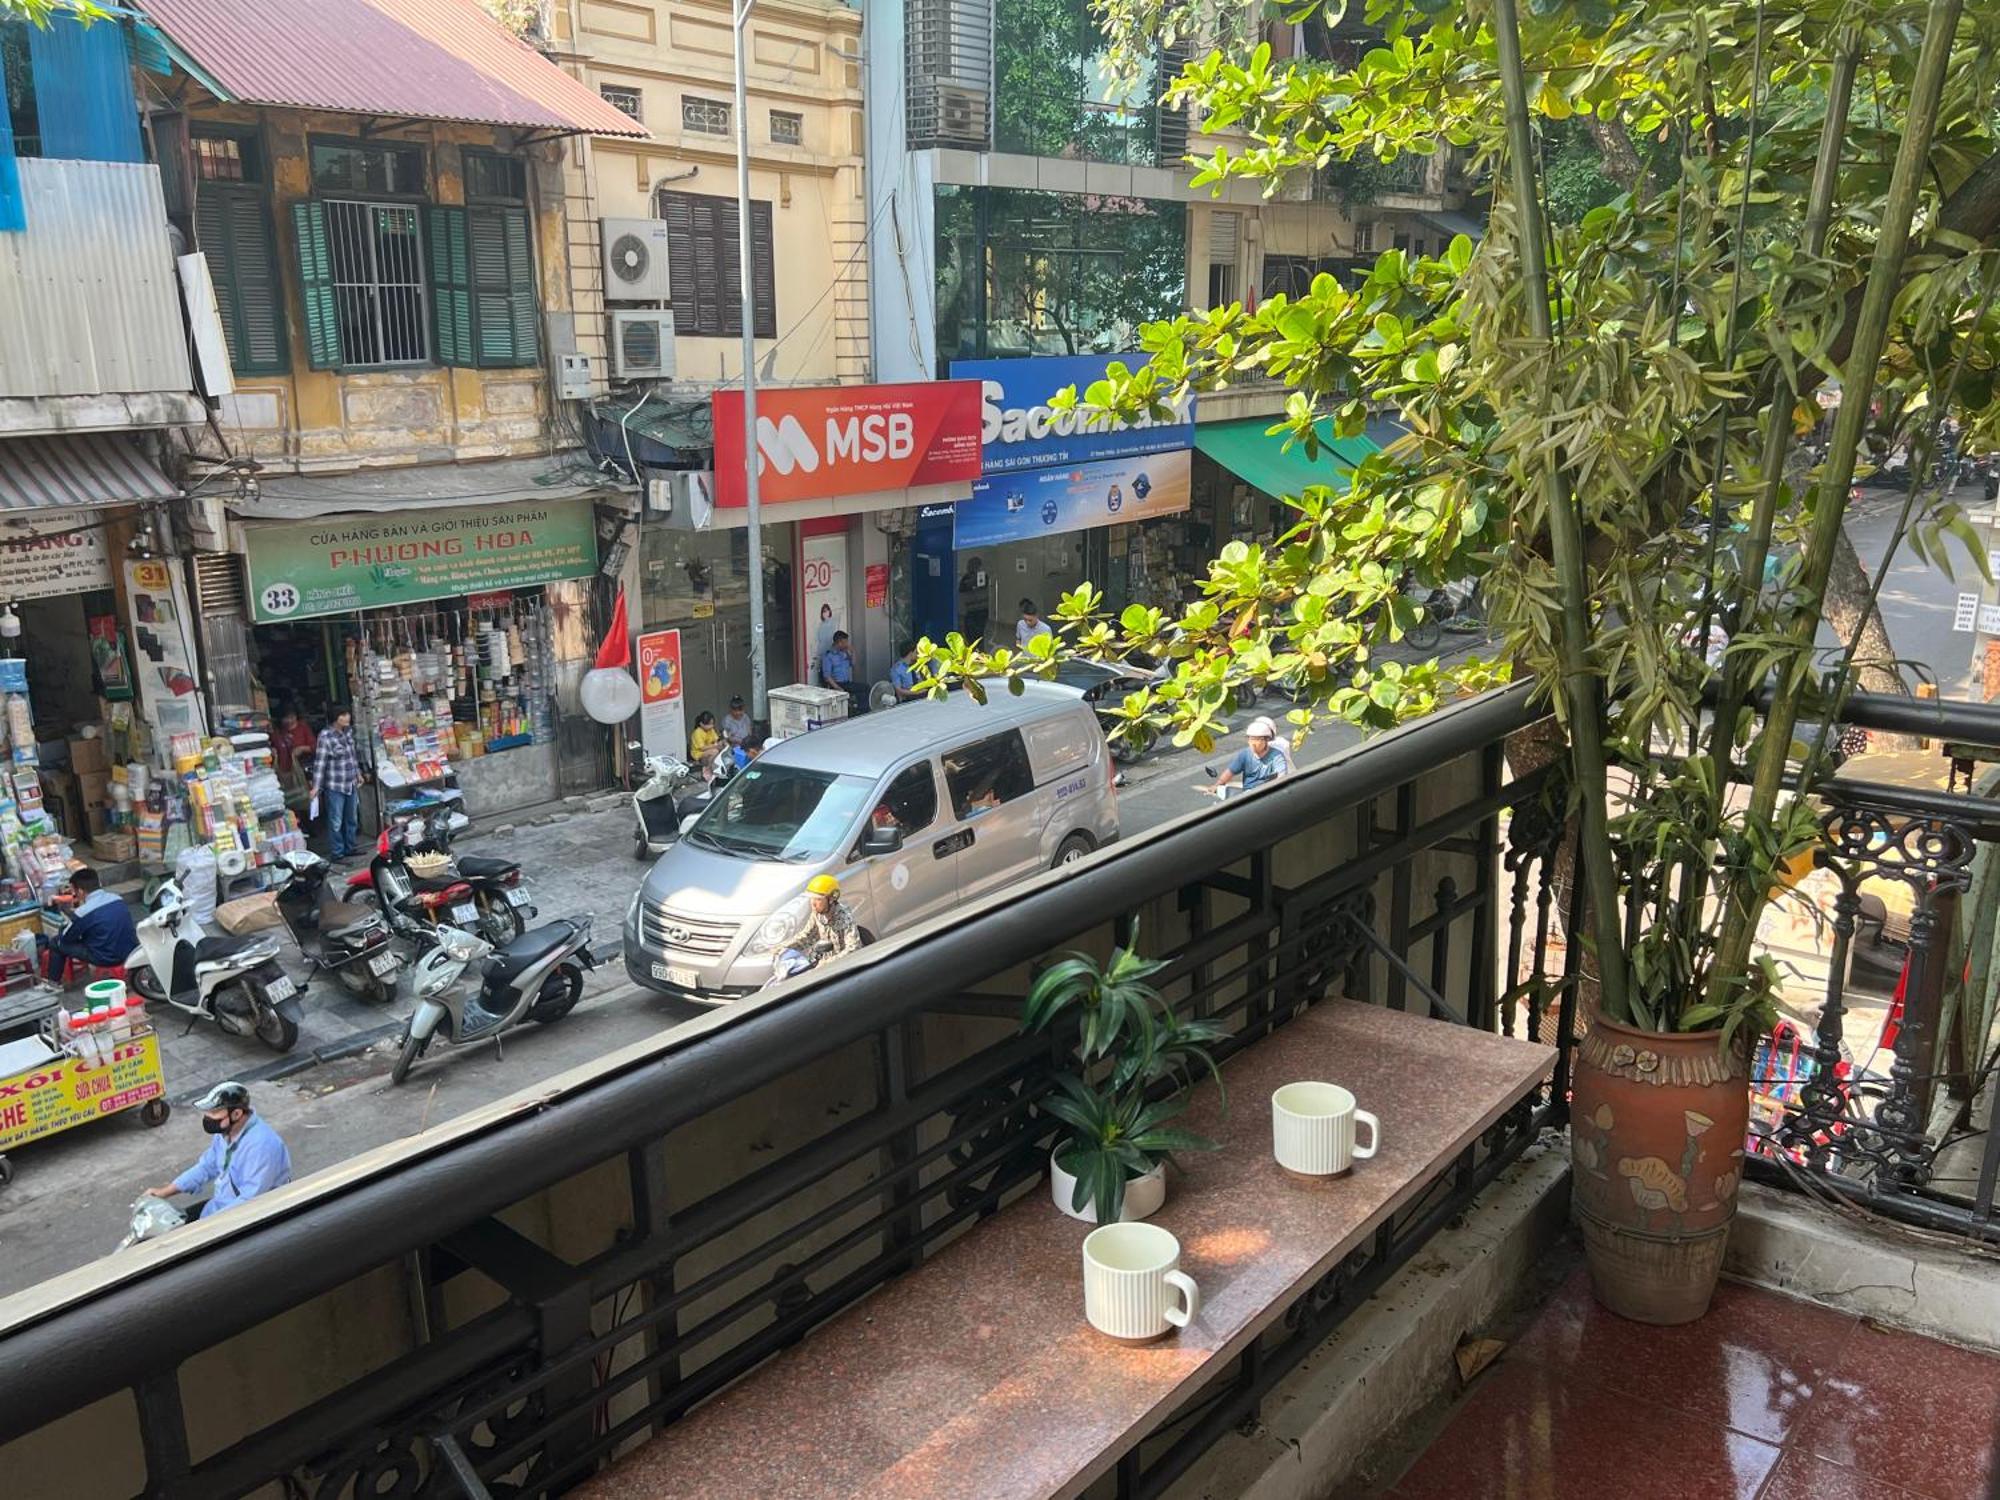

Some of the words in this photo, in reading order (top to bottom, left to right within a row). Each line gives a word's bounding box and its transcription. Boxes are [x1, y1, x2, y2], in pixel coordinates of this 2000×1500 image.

[826, 412, 914, 466] MSB
[342, 526, 380, 541] HÀNG
[474, 530, 533, 551] HOA
[805, 561, 831, 589] 20
[267, 588, 296, 610] 33
